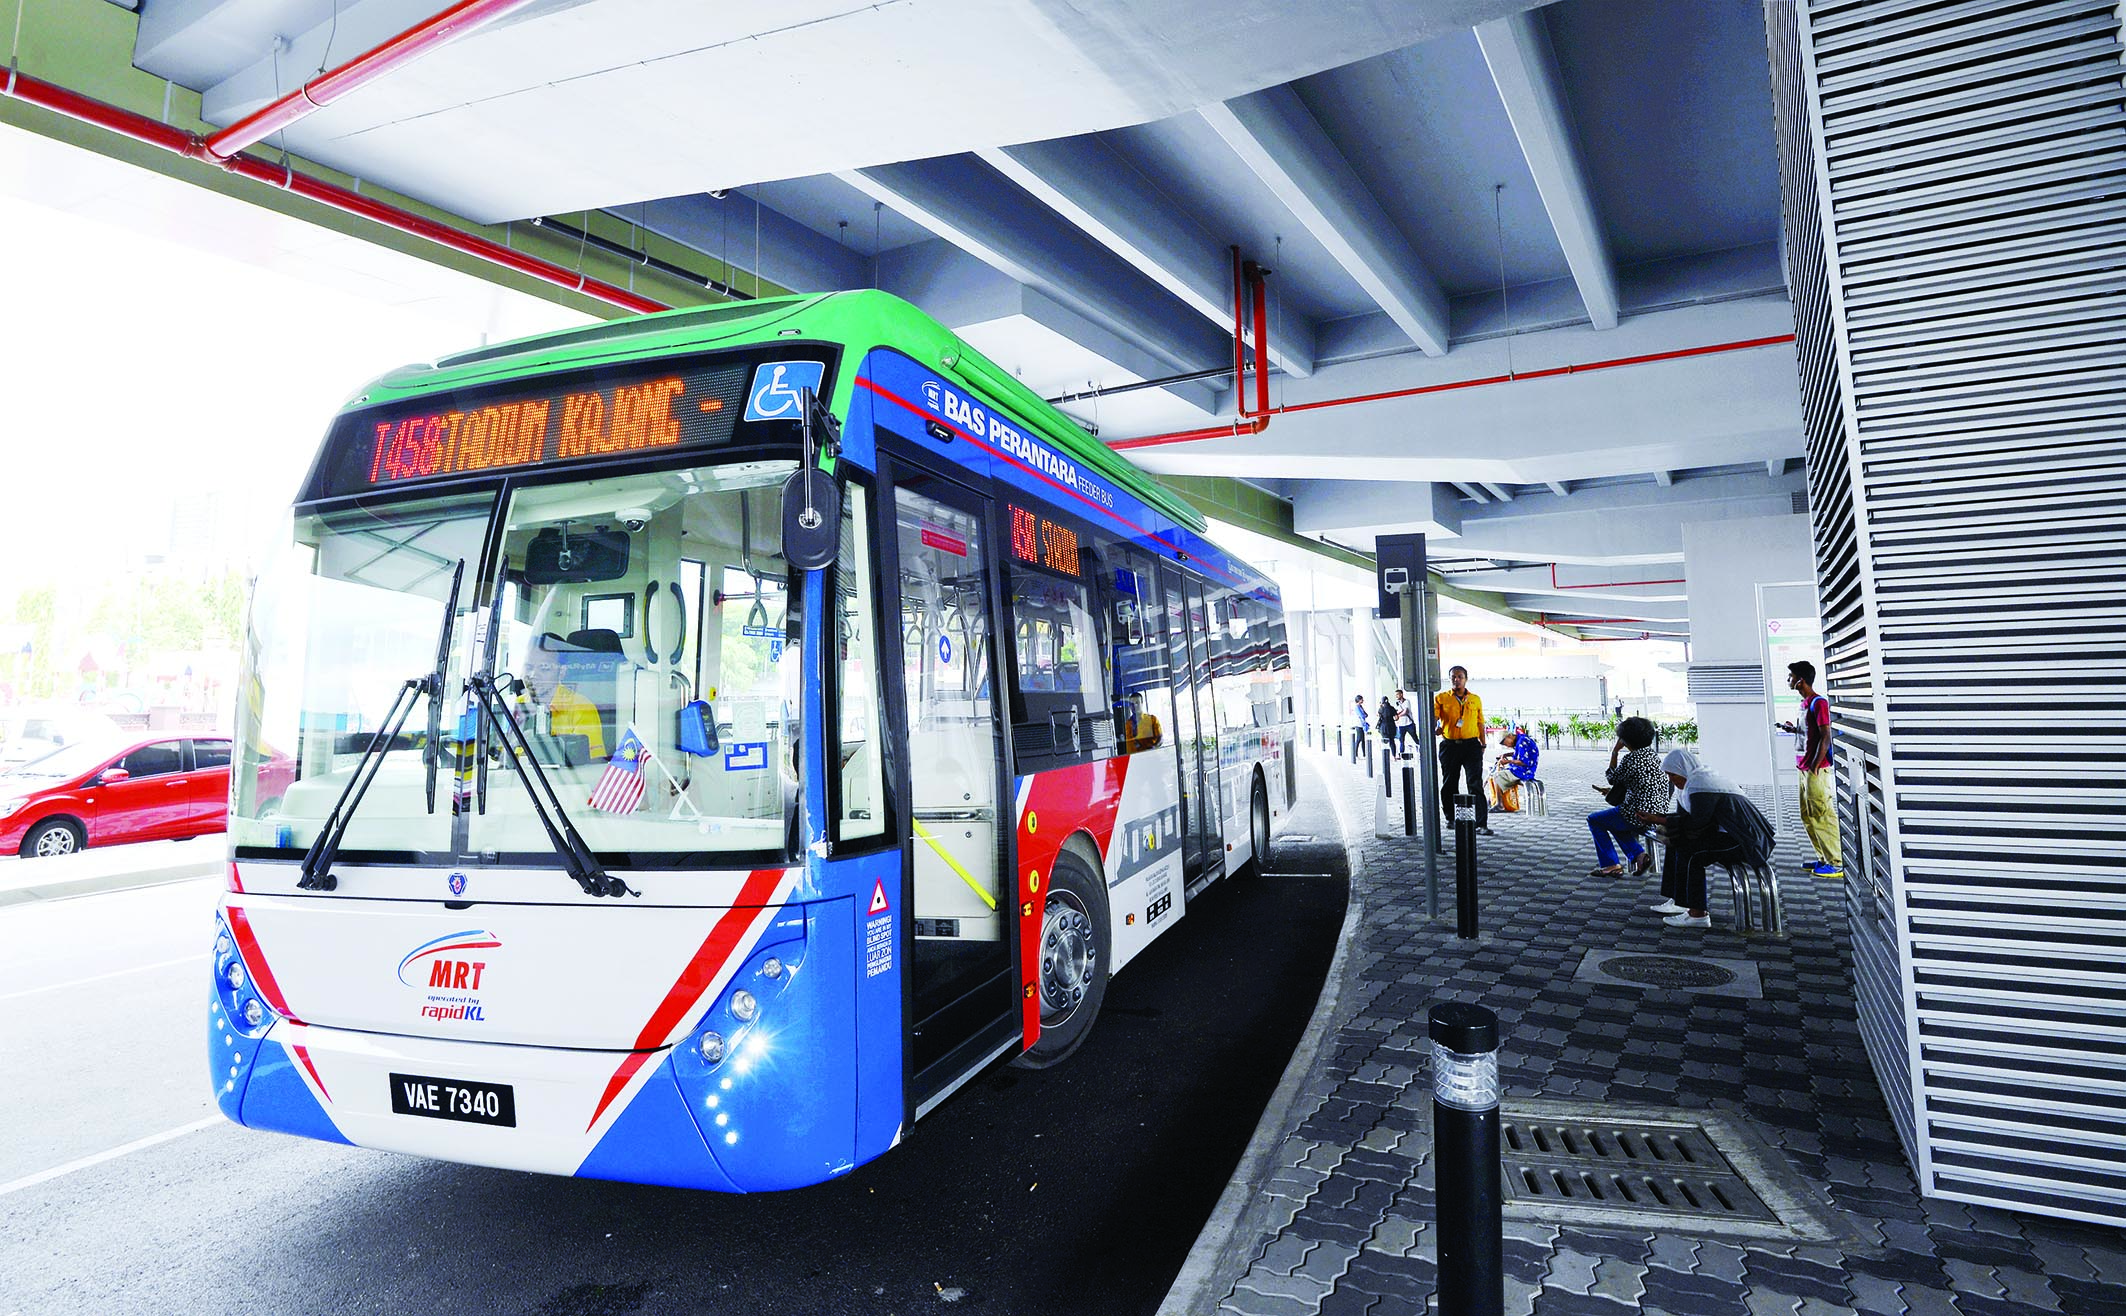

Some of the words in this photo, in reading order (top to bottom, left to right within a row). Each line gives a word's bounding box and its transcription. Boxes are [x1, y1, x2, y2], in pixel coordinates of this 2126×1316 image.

[944, 389, 986, 437] BAS
[989, 416, 1078, 488] PERANTARA
[1078, 475, 1101, 502] FEEDER
[1101, 488, 1114, 508] BUS
[880, 929, 892, 941] SPOT
[866, 951, 880, 963] LUAR
[428, 959, 486, 991] MRT
[421, 1004, 485, 1022] rapidKL
[403, 1082, 440, 1111] VAE
[445, 1086, 500, 1118] 7340
